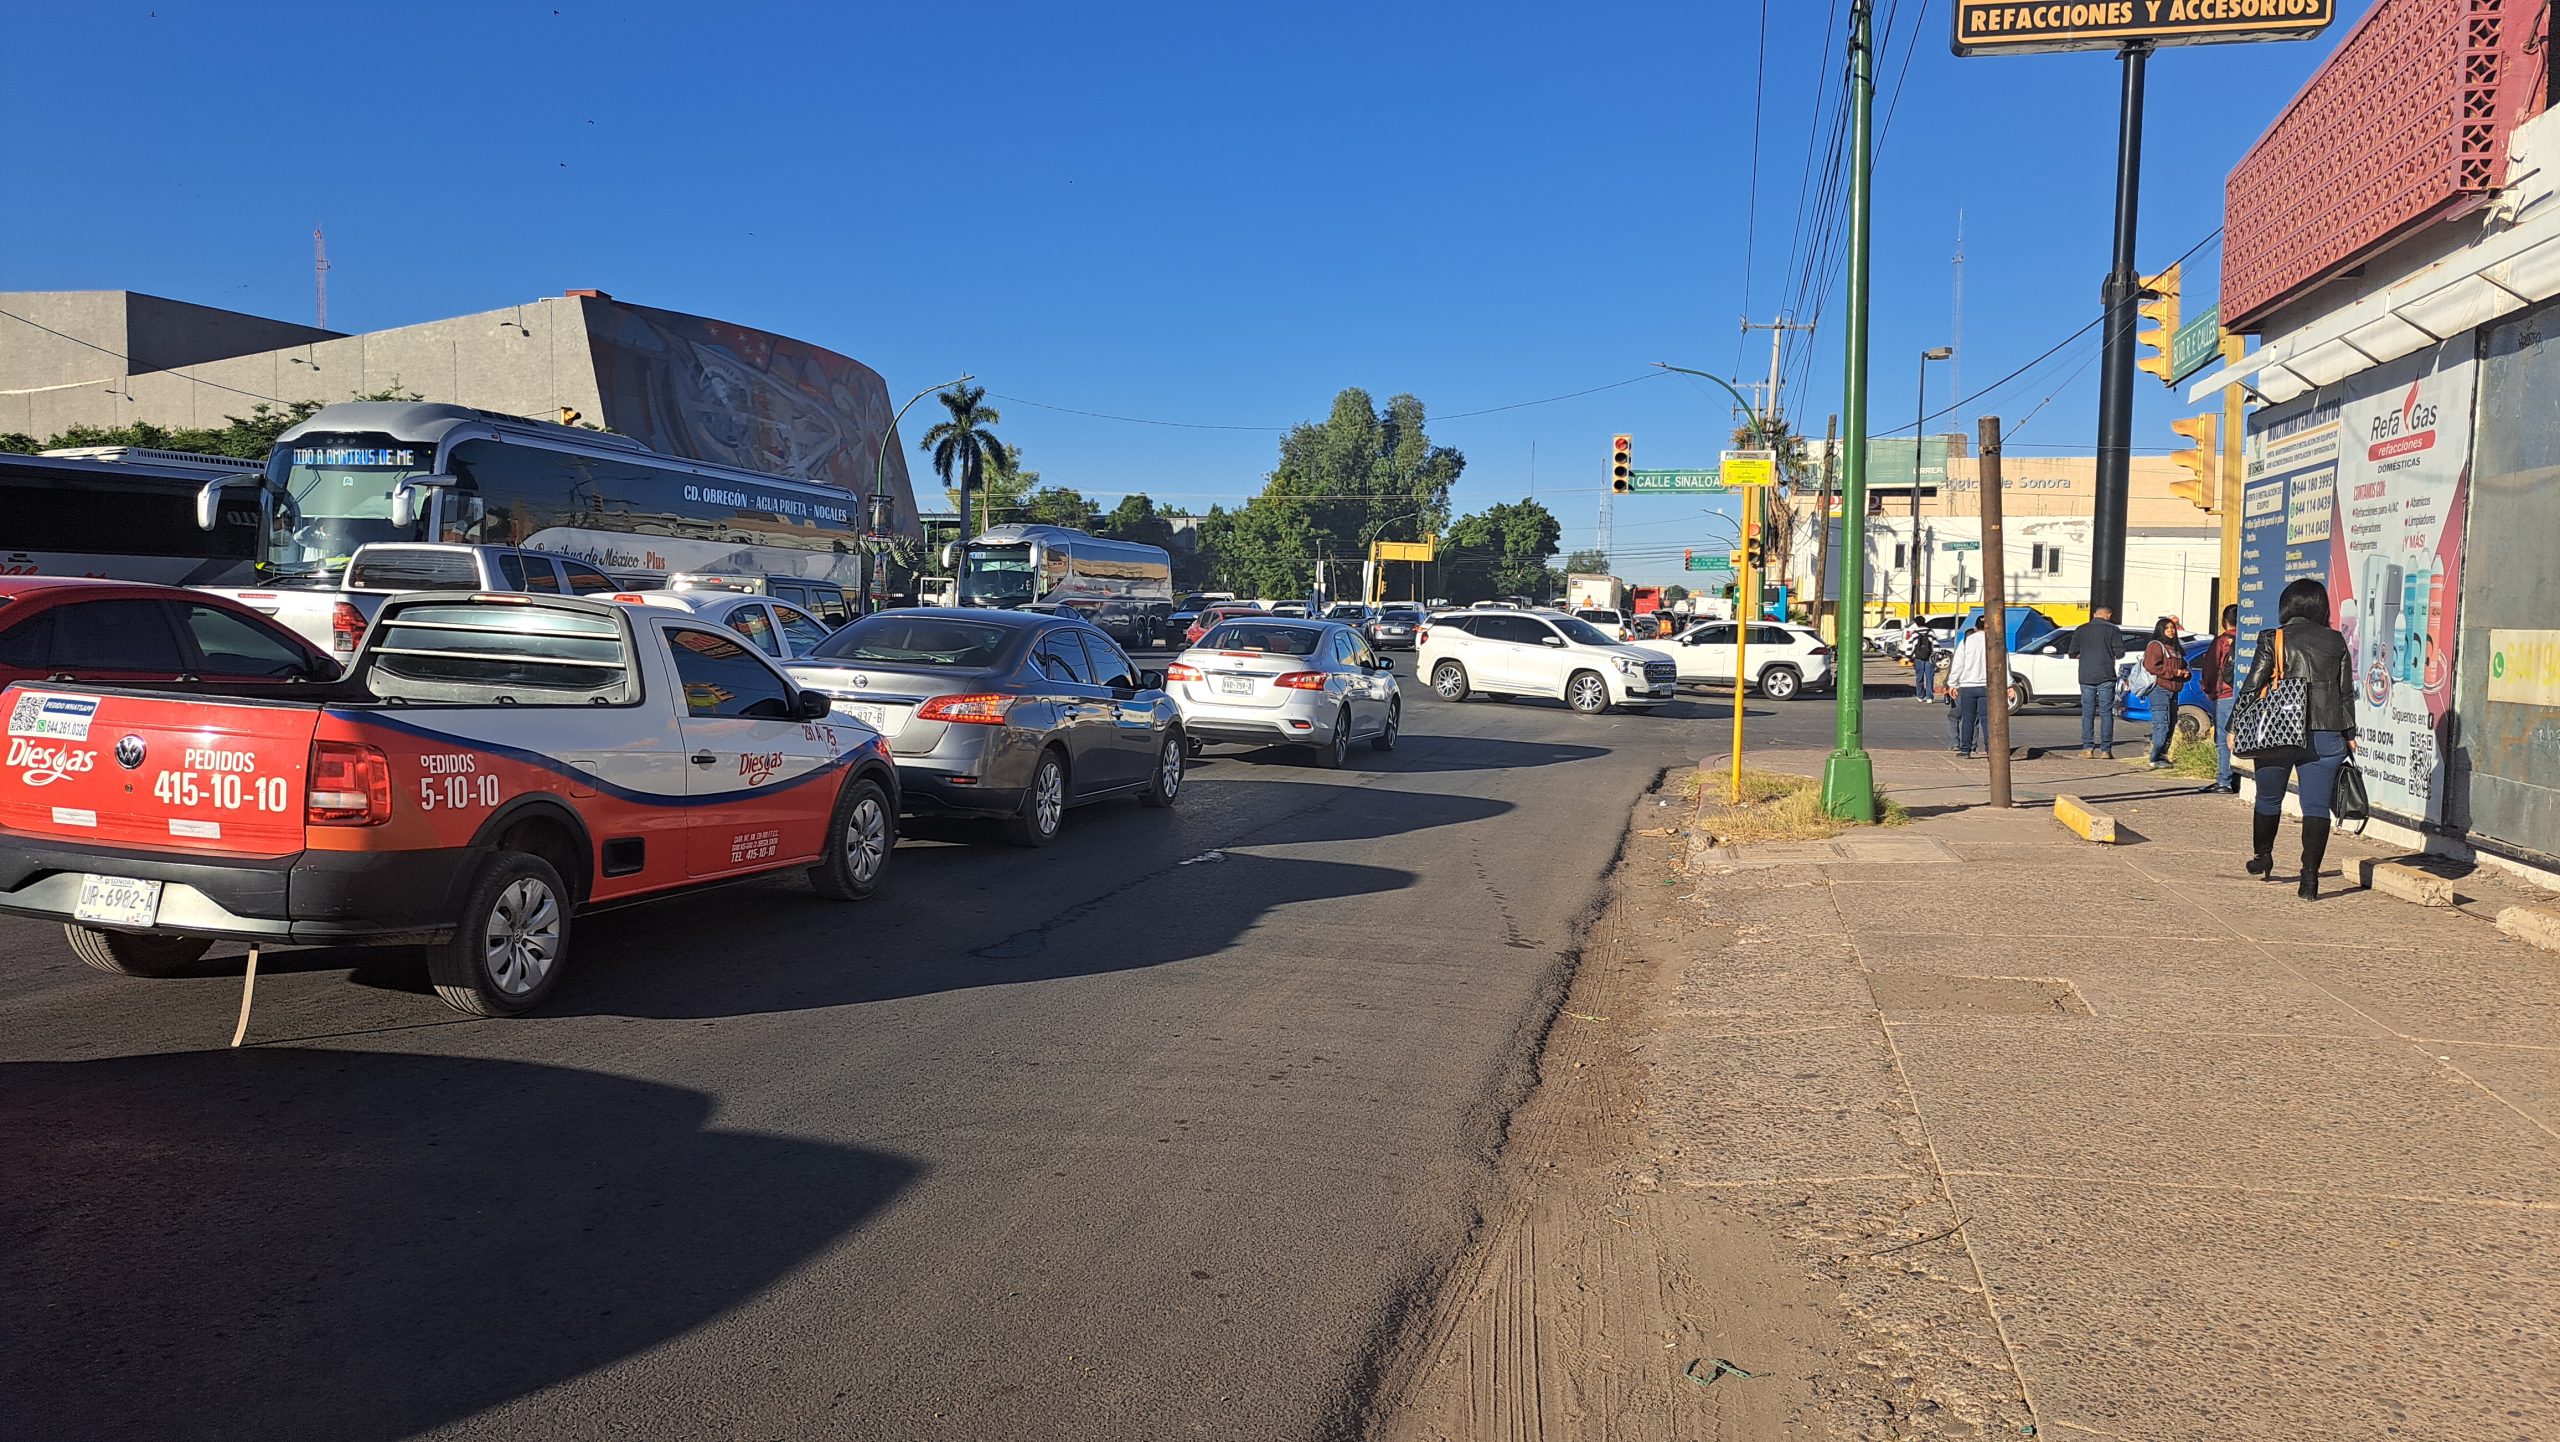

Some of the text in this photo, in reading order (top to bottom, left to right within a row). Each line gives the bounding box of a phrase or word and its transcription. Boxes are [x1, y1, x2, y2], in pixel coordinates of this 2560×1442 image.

[1970, 0, 2320, 32] REFACCIONES Y ACCESORIOS
[2370, 403, 2437, 441] Refa Gas
[317, 449, 323, 465] A
[326, 449, 375, 465] OMNIBUS
[378, 449, 393, 465] DE
[397, 449, 414, 466] ME
[2378, 438, 2422, 457] refacciones
[2378, 457, 2420, 474] DOMÉSTICAS
[1637, 474, 1670, 488] CALLE
[1675, 473, 1720, 488] SINALOA
[2020, 477, 2070, 489] Sonora
[2297, 480, 2306, 494] 644
[2319, 473, 2332, 489] 3995
[684, 484, 701, 502] CD.
[703, 488, 747, 507] OBREGÓN
[756, 495, 778, 512] AGUA
[780, 499, 807, 516] PRIETA
[813, 504, 847, 522] NOGALES
[2296, 496, 2331, 516] 644 114 0439
[2410, 496, 2431, 508] Abanicos
[2294, 520, 2329, 538] 644 114 0438
[2408, 514, 2436, 528] Limpiadores
[585, 546, 597, 565] de
[600, 548, 639, 568] México
[647, 551, 666, 570] Plus
[65, 703, 94, 712] WHATSAPP
[47, 721, 87, 737] 644.261.0326
[823, 726, 836, 746] 75
[2367, 728, 2376, 743] 138
[2378, 730, 2393, 746] 0074
[6, 738, 98, 786] Diesgas
[185, 749, 255, 773] PEDIDOS
[739, 752, 783, 786] Diesgas
[154, 771, 287, 812] 415-10-10
[420, 774, 499, 810] 5-10-10
[746, 845, 776, 860] 415-10-10
[81, 884, 153, 911] UR-6982-A
